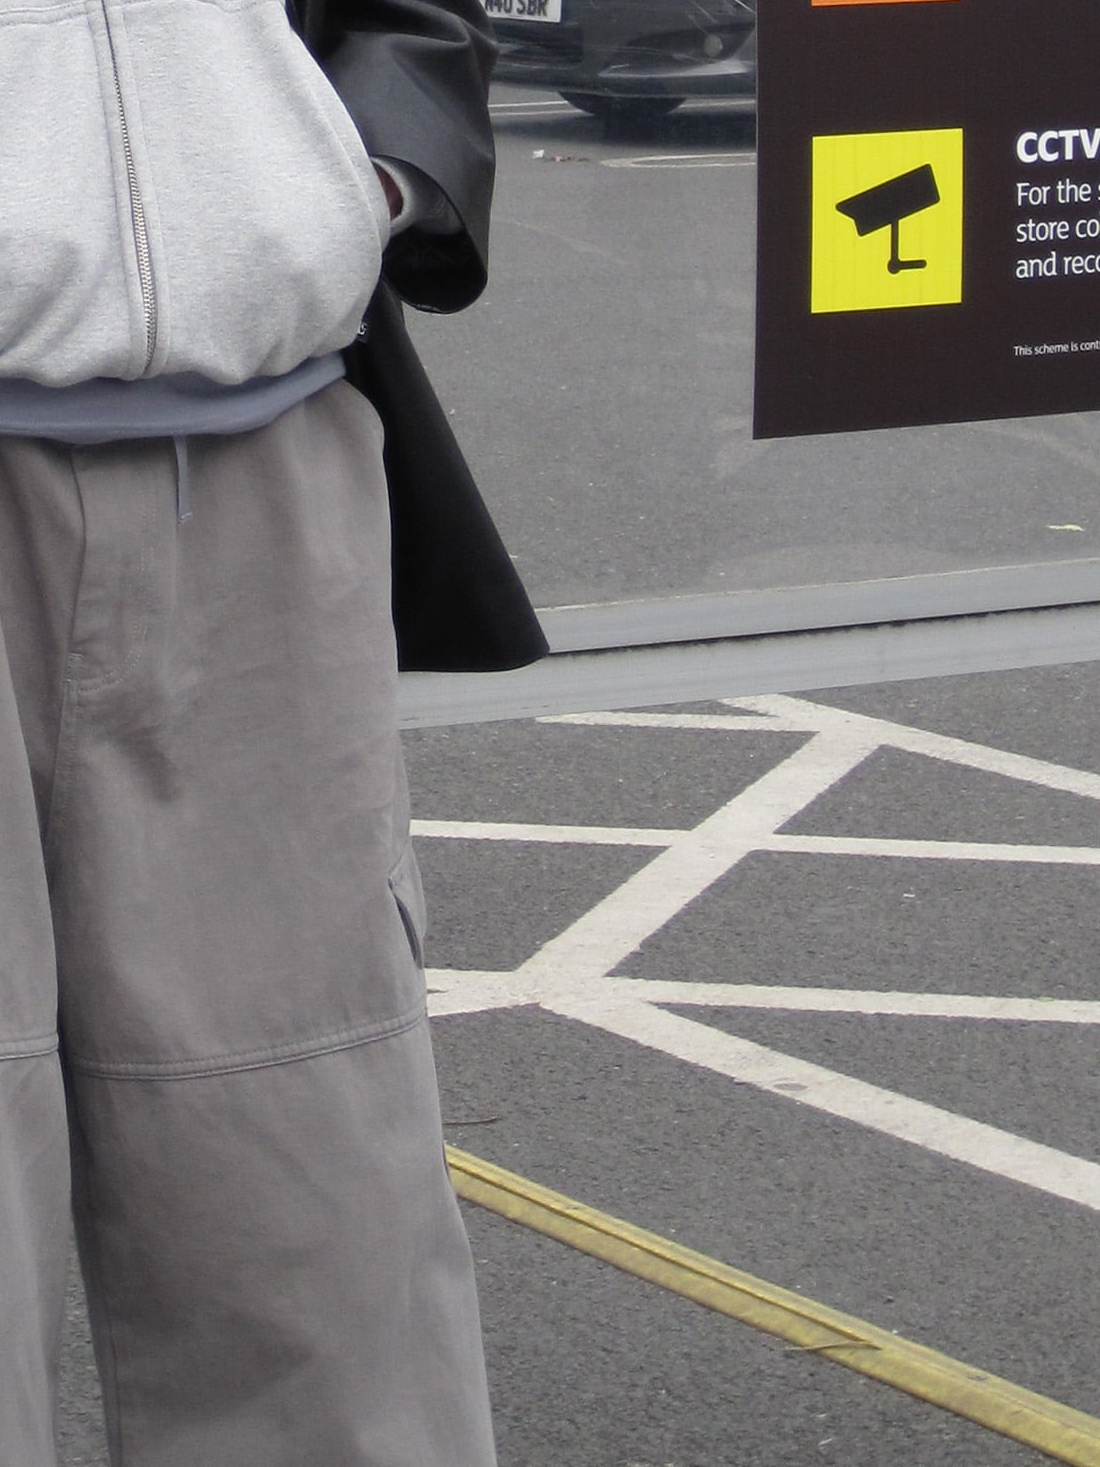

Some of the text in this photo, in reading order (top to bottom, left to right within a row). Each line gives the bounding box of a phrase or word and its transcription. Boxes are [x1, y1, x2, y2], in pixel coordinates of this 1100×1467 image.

[1016, 128, 1100, 164] CCTV
[1016, 182, 1051, 207] For
[1056, 178, 1092, 204] the
[1016, 217, 1100, 243] store co
[1015, 251, 1058, 279] and
[1013, 340, 1100, 356] This scheme is cont
